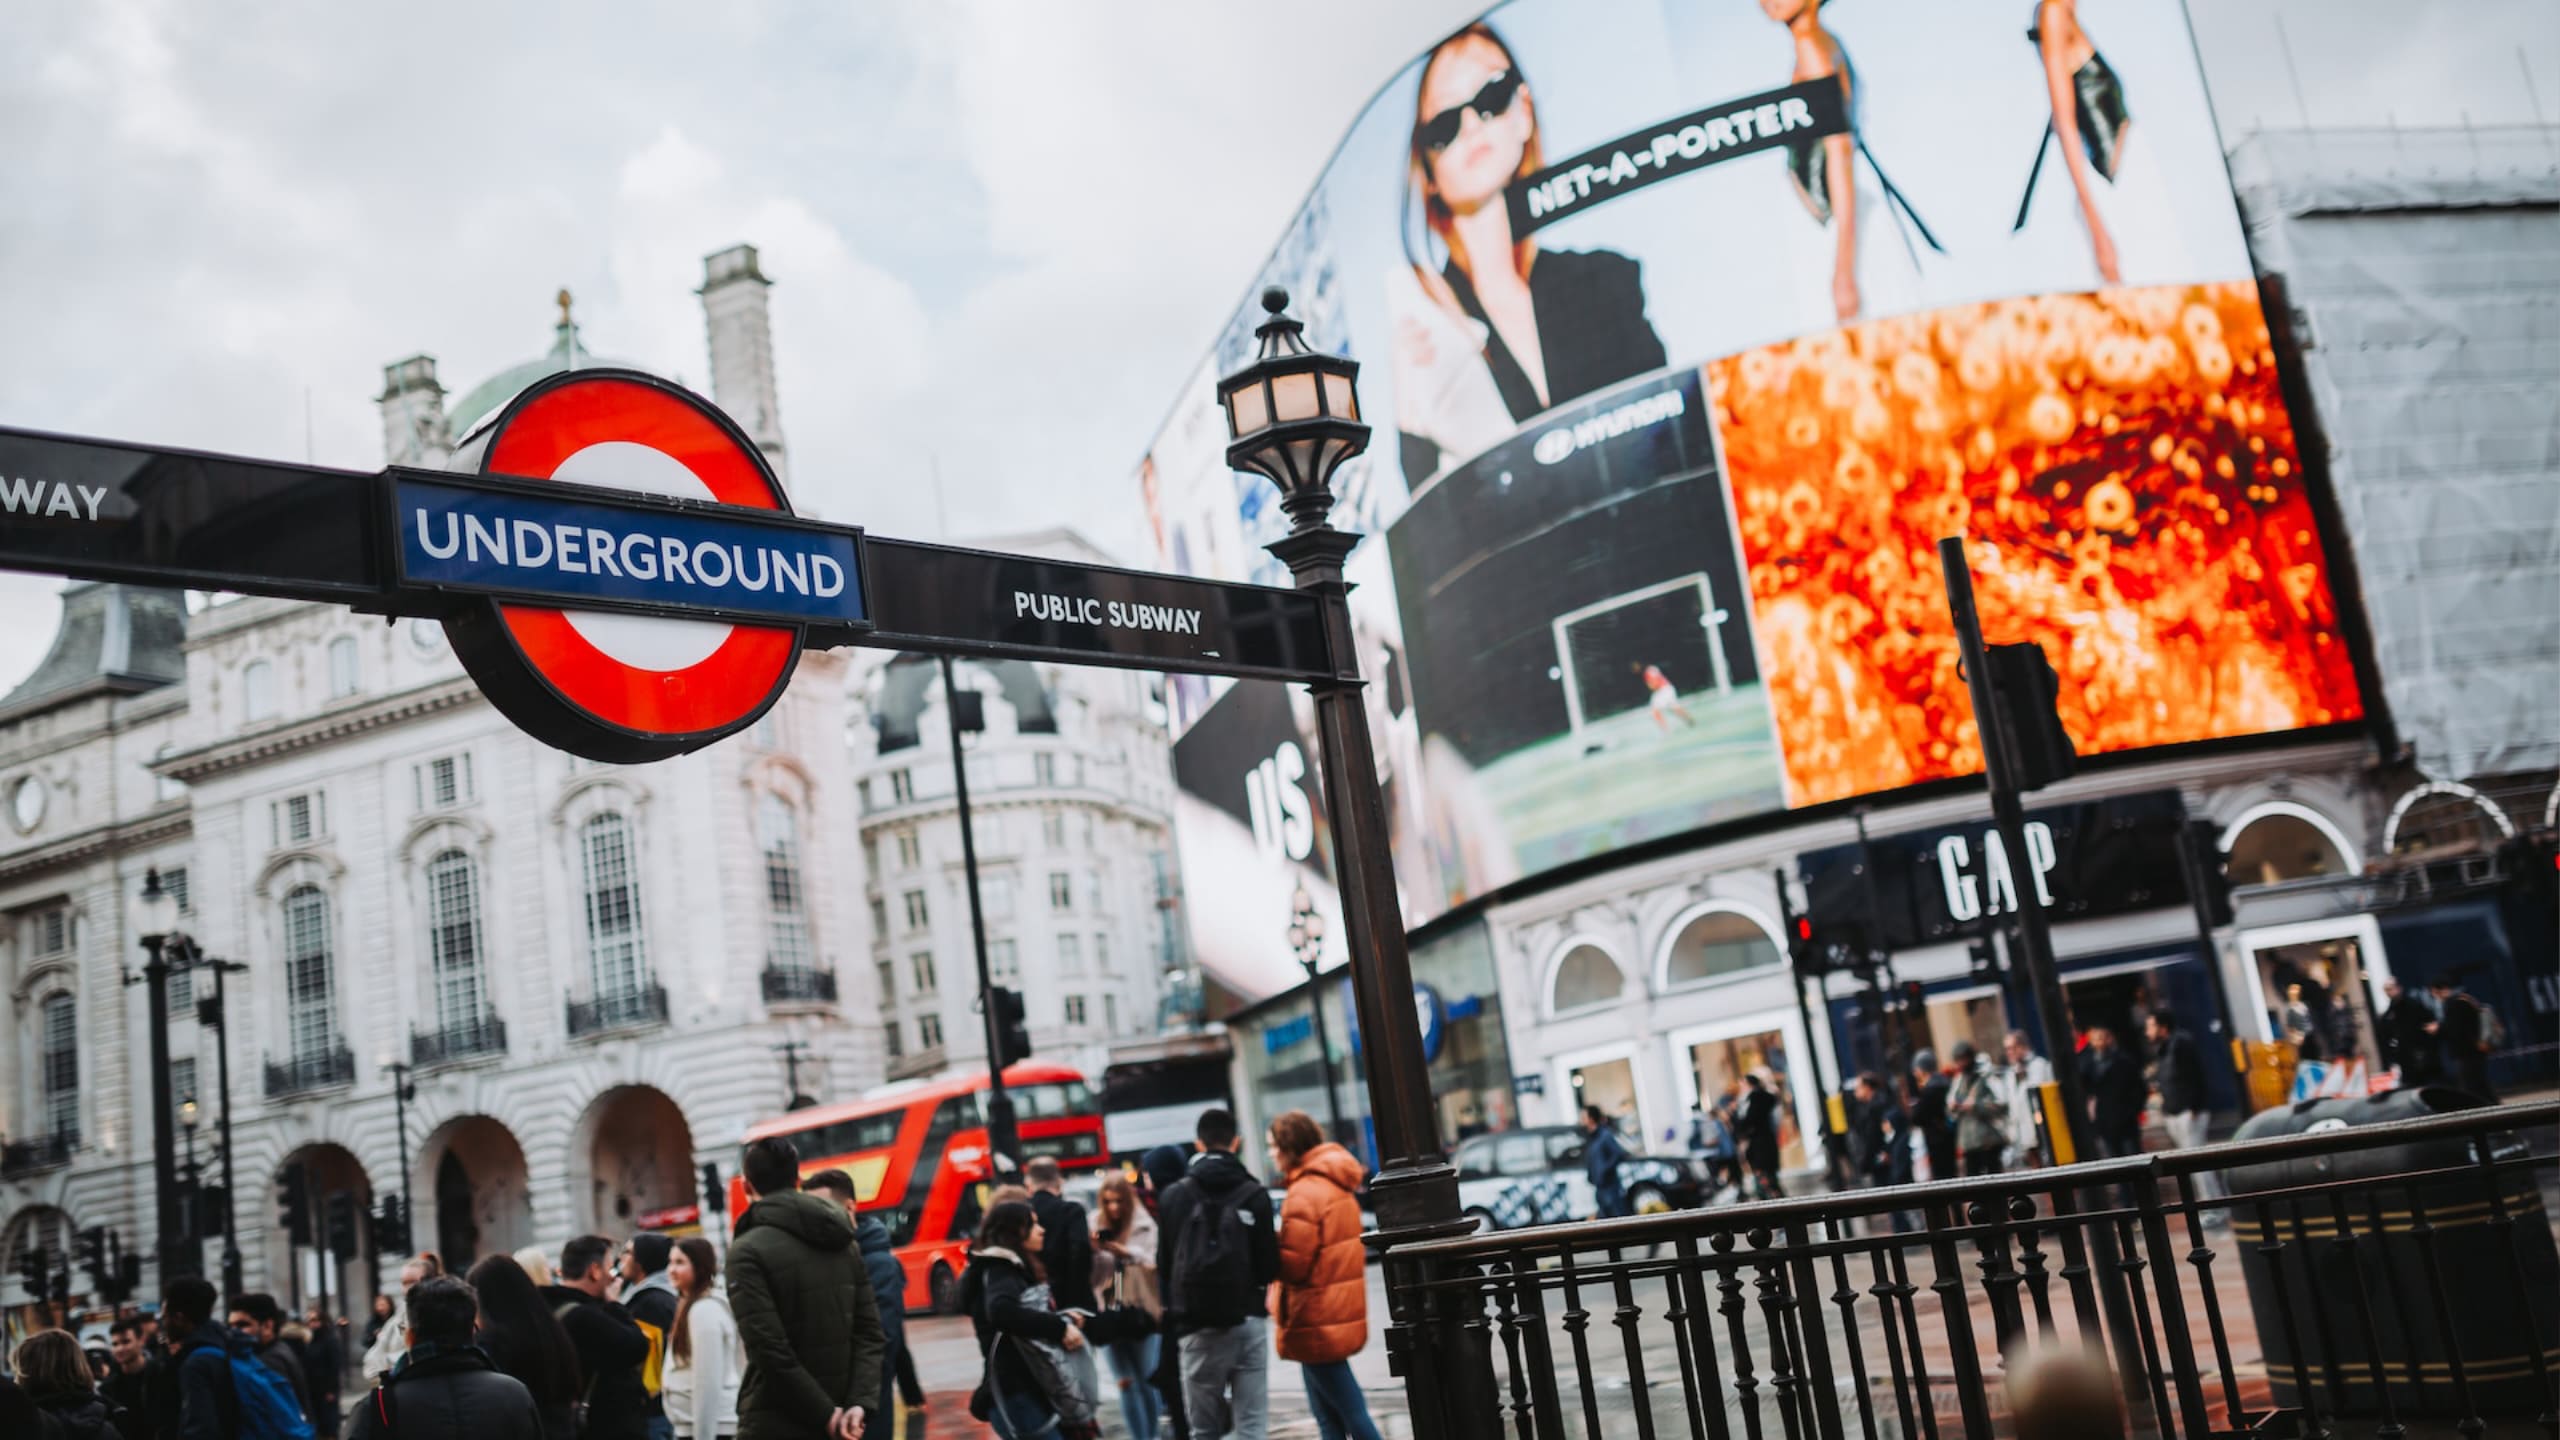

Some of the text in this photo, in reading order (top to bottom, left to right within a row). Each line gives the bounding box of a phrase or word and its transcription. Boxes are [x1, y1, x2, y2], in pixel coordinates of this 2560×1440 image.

[1527, 97, 1815, 218] NET-A-PORTER
[0, 475, 108, 521] WAY
[416, 508, 845, 599] UNDERGROUND
[1014, 591, 1201, 635] PUBLIC SUBWAY
[1245, 741, 1315, 861] US
[1937, 821, 2057, 921] GAP
